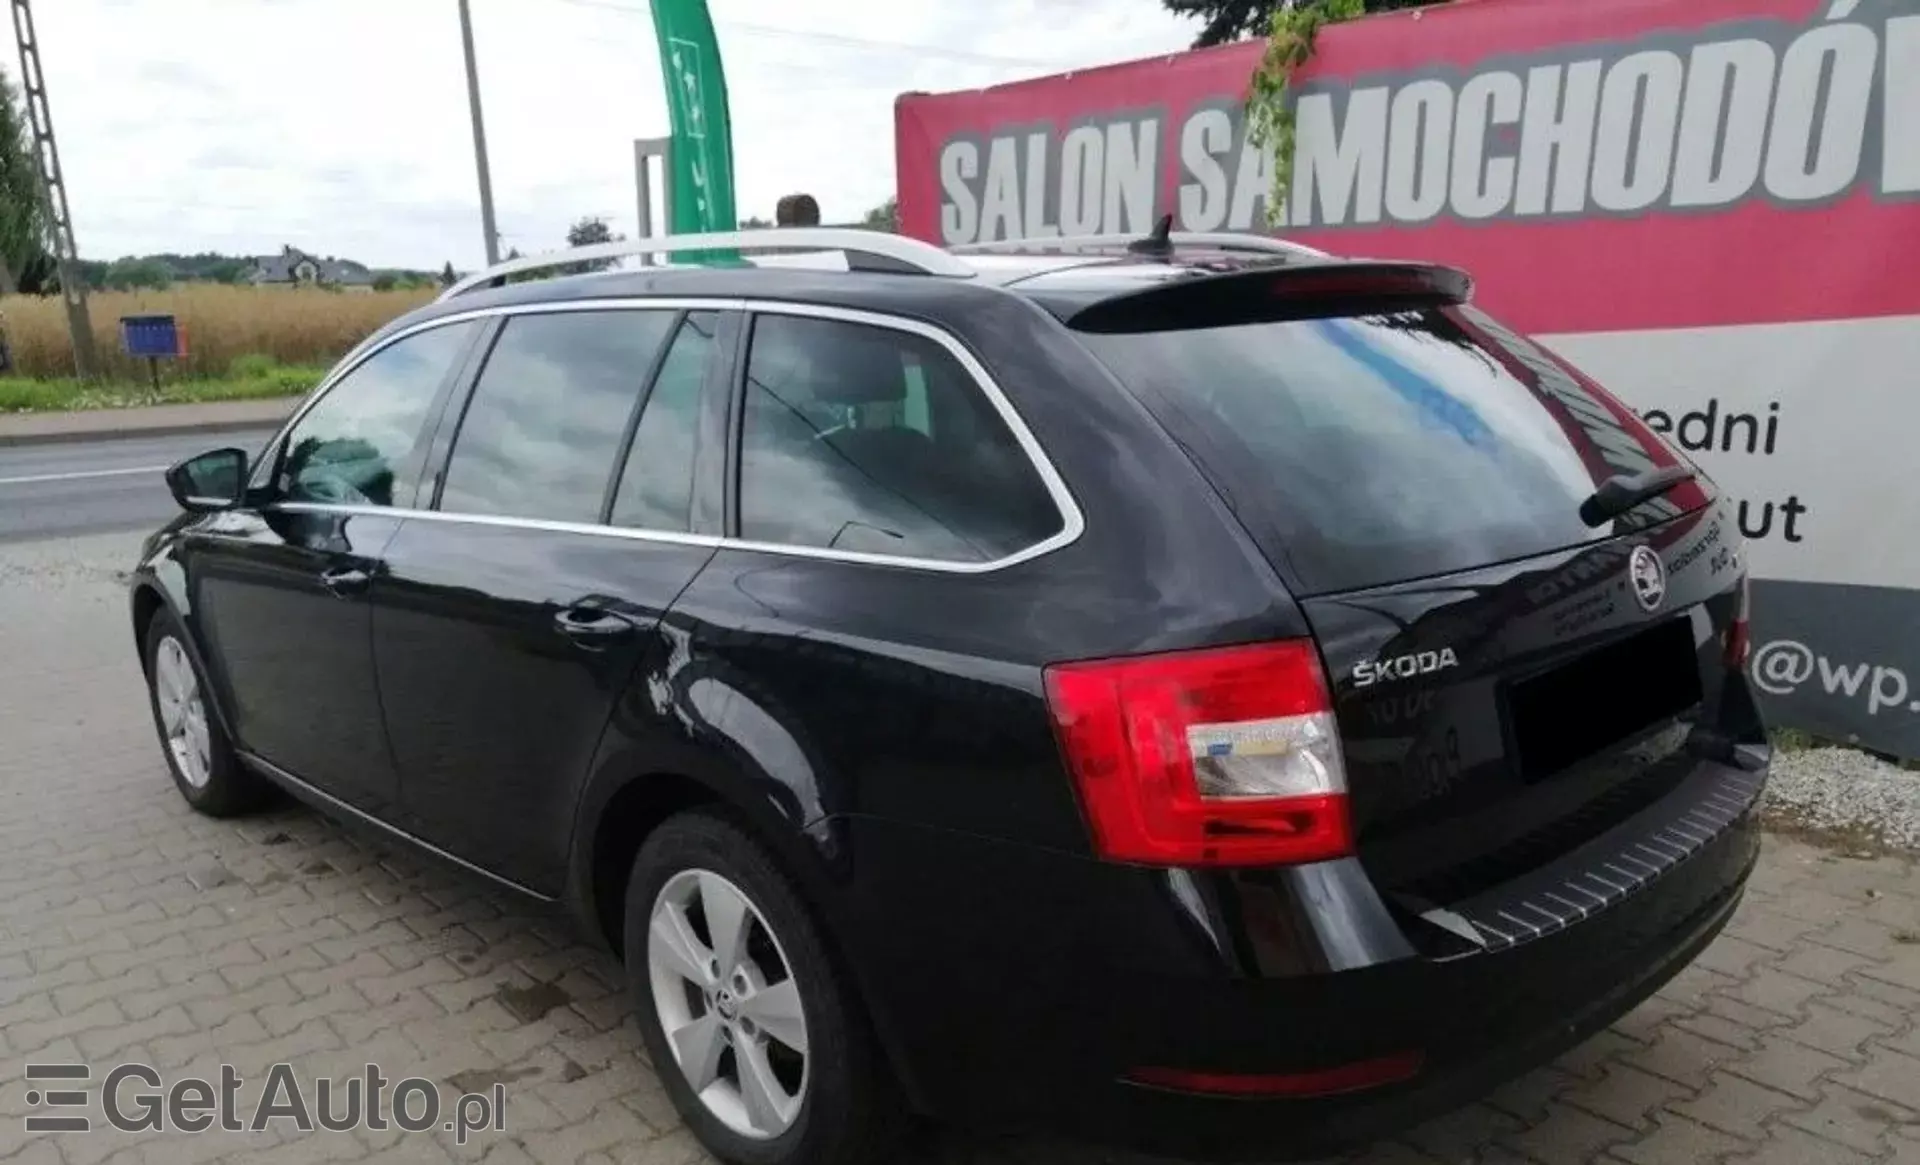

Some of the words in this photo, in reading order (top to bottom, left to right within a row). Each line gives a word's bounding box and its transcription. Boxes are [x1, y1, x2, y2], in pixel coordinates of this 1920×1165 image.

[940, 120, 1158, 245] SALON
[1630, 398, 1780, 454] edni
[1352, 647, 1459, 688] ŠKODA
